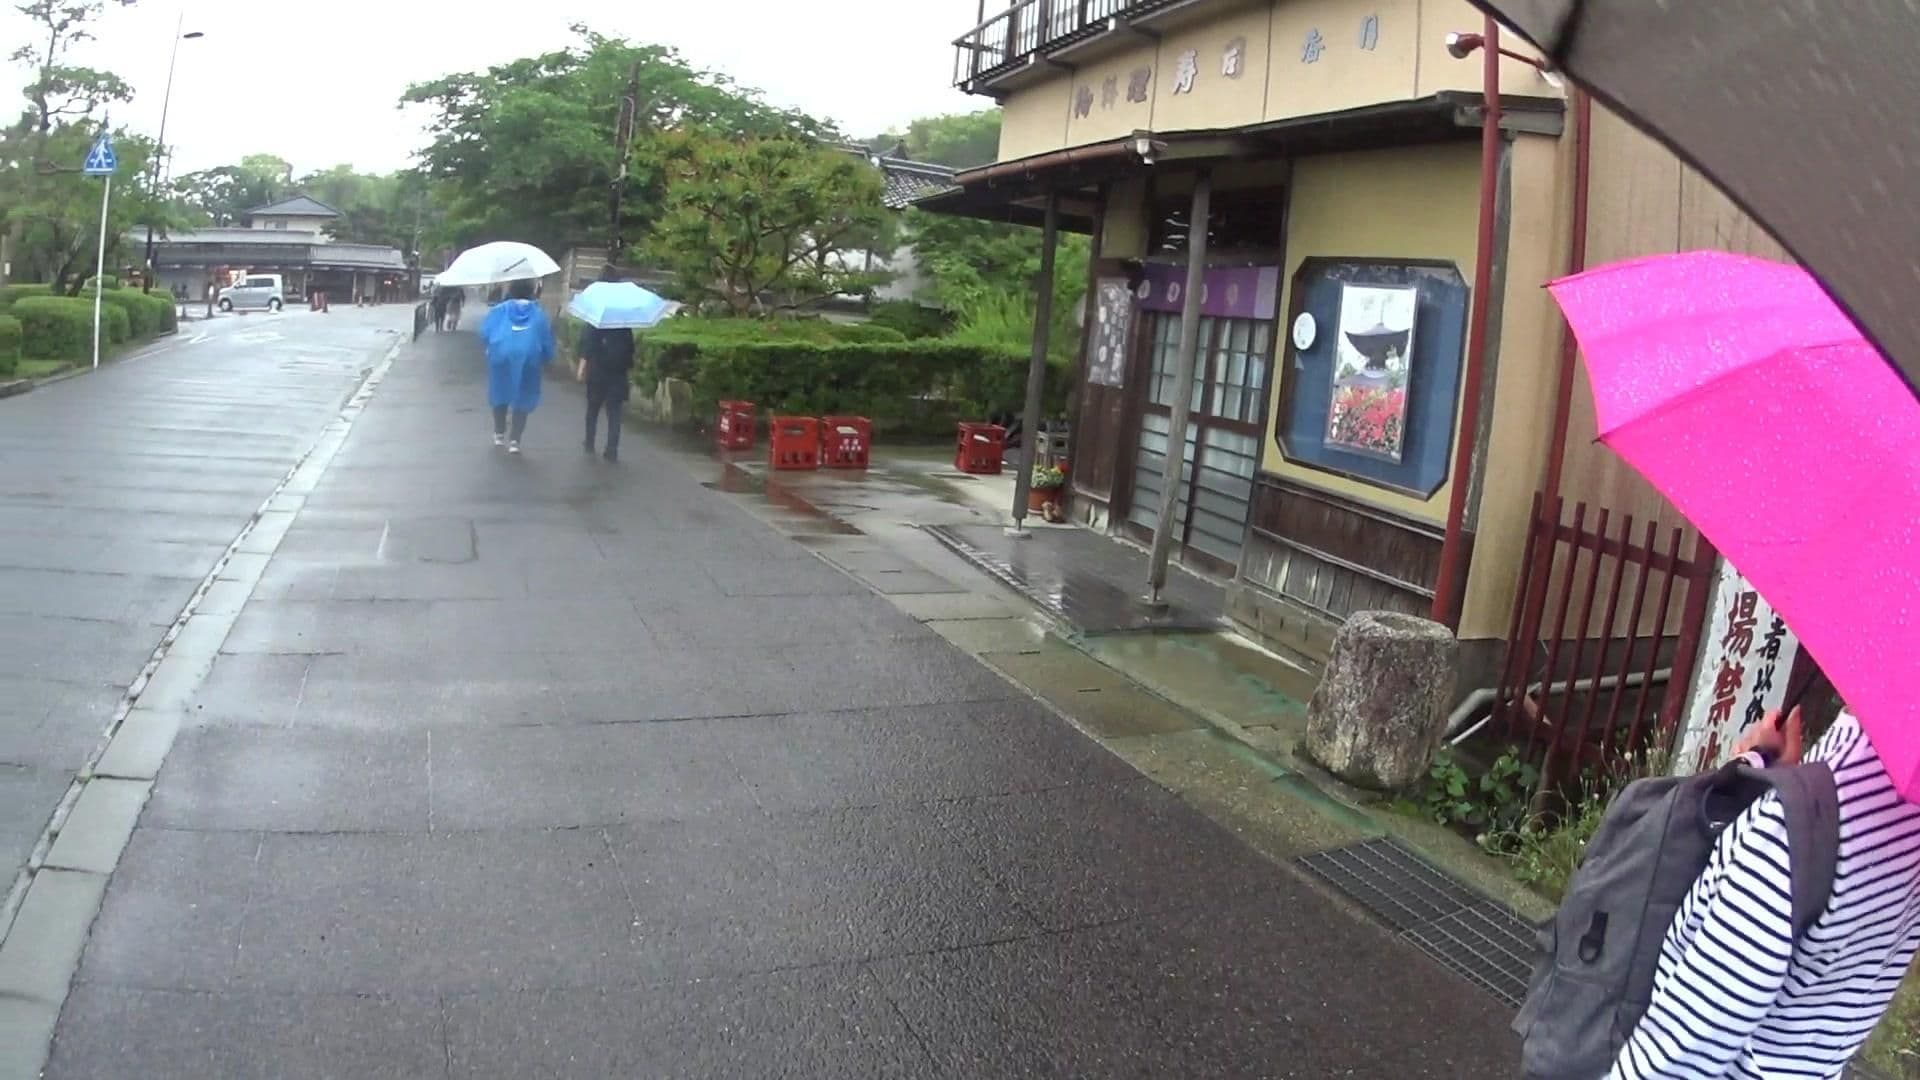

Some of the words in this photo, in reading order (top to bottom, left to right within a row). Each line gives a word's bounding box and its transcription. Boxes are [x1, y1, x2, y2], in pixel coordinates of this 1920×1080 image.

[1696, 571, 1759, 773] 場禁止
[1740, 607, 1787, 733] 者以外
